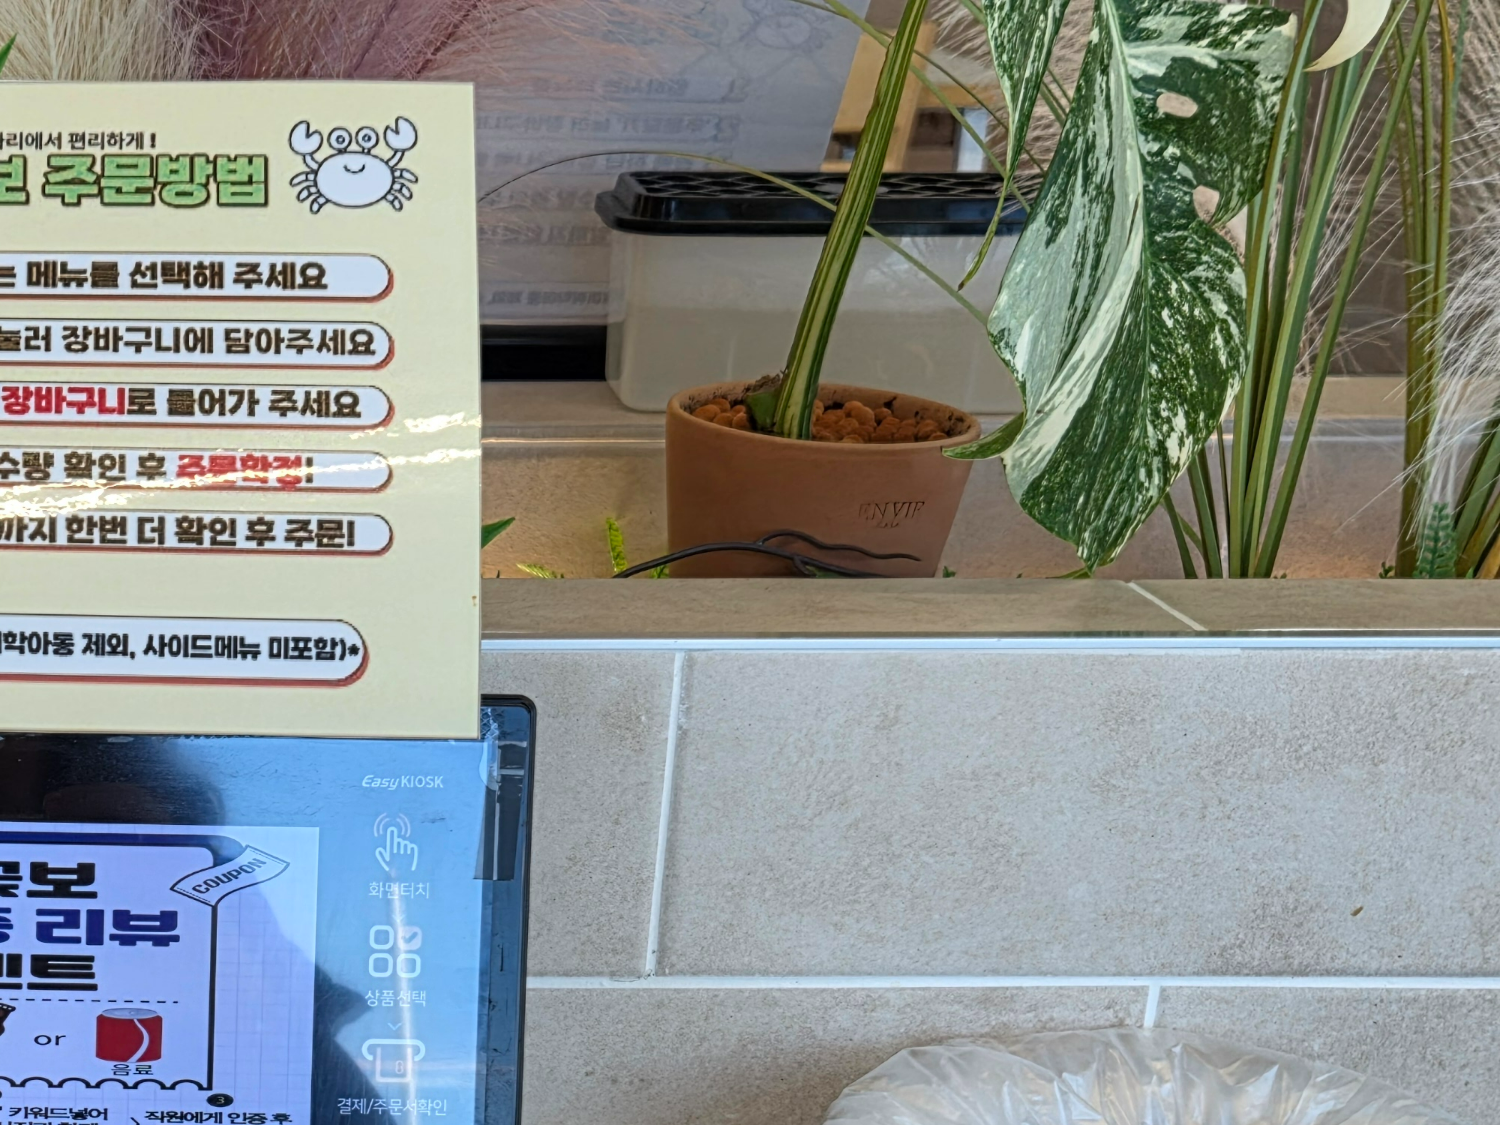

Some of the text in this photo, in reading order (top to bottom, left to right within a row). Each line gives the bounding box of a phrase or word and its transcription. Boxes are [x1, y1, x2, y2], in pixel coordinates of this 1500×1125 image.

[69, 132, 144, 149] 편리하게
[42, 153, 269, 207] 주문방법
[27, 260, 119, 289] 메뉴를
[129, 261, 224, 290] 선택해
[233, 262, 328, 290] 주세요
[62, 325, 214, 354] 장바구니에
[224, 328, 376, 355] 담아주세요
[2, 386, 157, 415] 장바구니로
[167, 388, 259, 416] 들어가
[269, 389, 361, 418] 주세요
[63, 451, 126, 482] 확인
[136, 453, 167, 481] 후
[66, 514, 127, 545] 한번
[137, 516, 166, 545] 더
[175, 516, 237, 547] 확인
[246, 518, 276, 547] 후
[284, 519, 355, 548] 주문!
[81, 633, 135, 660] 제외,
[143, 633, 261, 661] 사이드메뉴
[192, 858, 266, 893] COUPON
[369, 882, 429, 899] 화면터치
[36, 908, 180, 947] 리뷰
[365, 990, 426, 1007] 상품선택
[34, 1033, 66, 1046] or
[111, 1064, 154, 1077] 음료
[145, 1110, 292, 1125] 직원에게 인증 후
